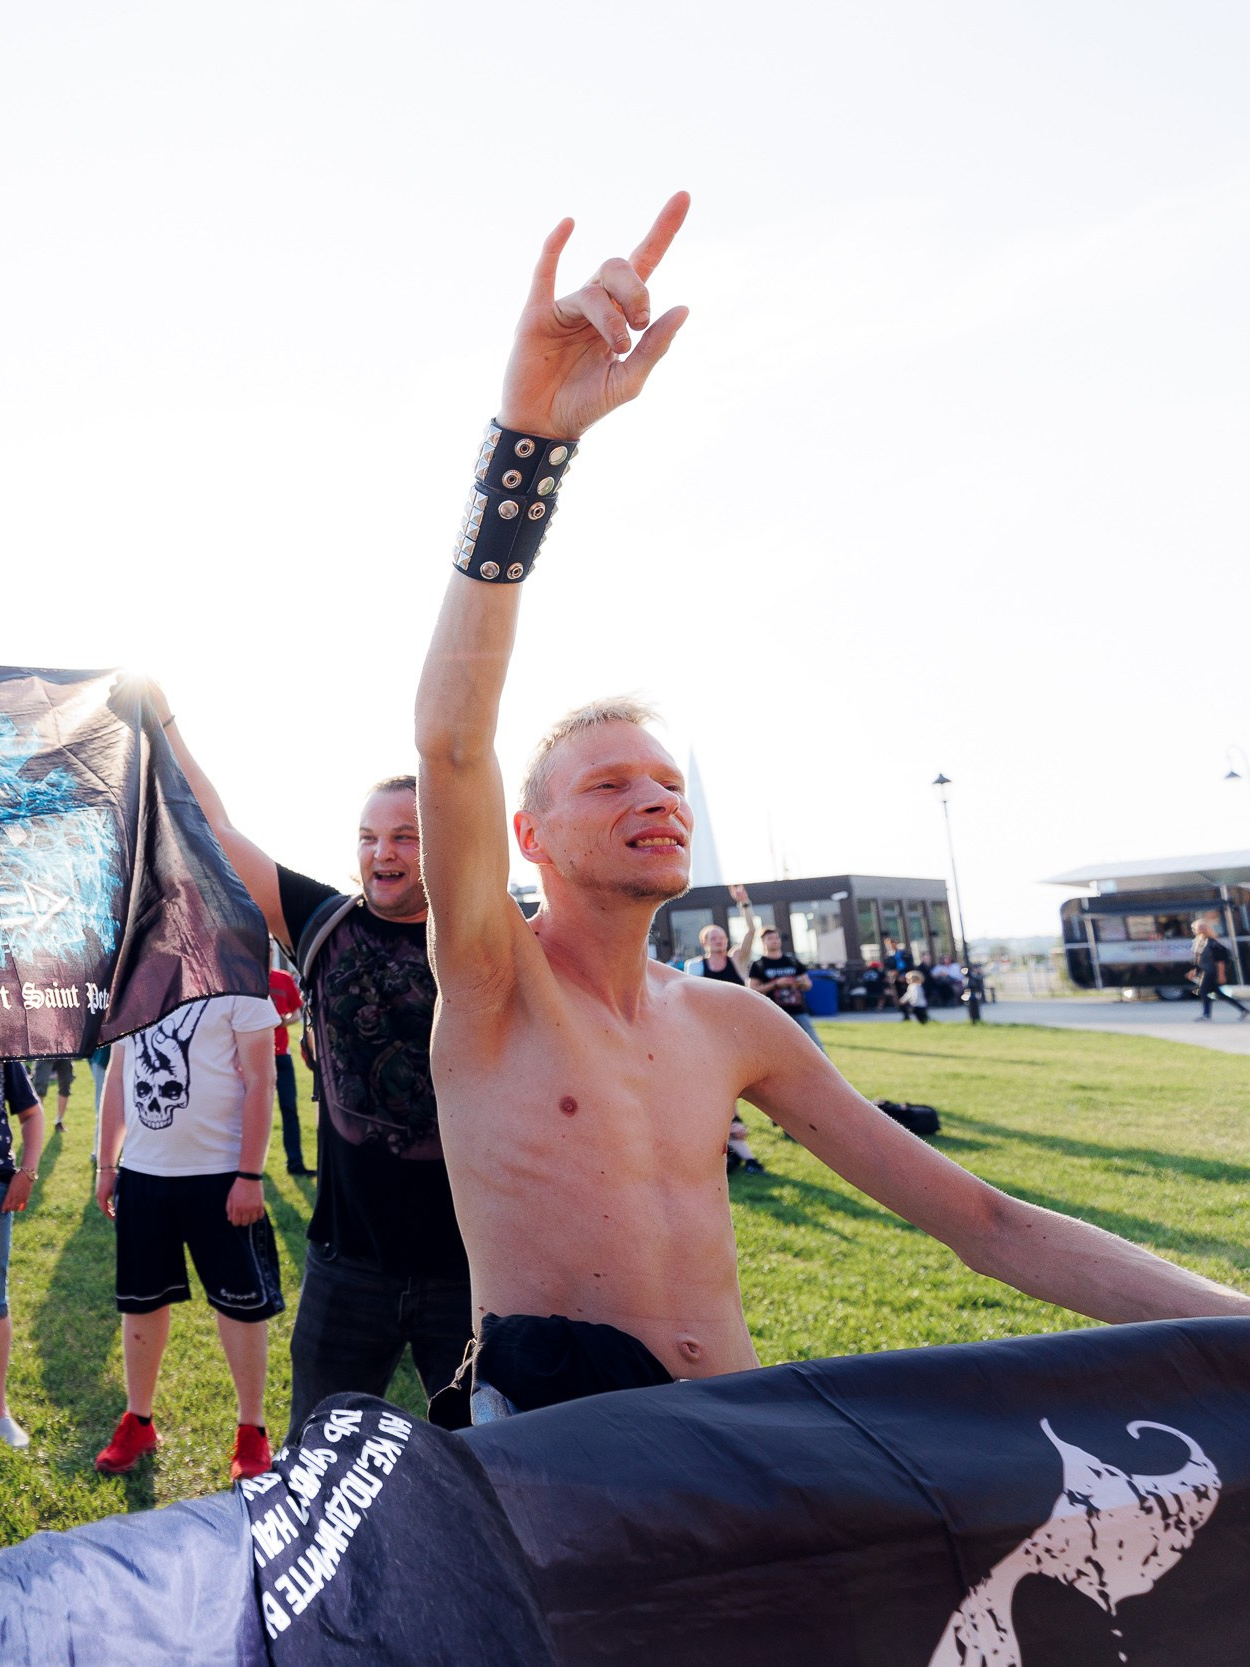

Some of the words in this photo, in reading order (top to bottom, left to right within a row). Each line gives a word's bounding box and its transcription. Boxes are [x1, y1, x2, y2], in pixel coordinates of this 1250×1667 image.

[21, 982, 80, 1010] Saint
[85, 981, 110, 1015] Pet
[378, 1411, 413, 1442] НУ
